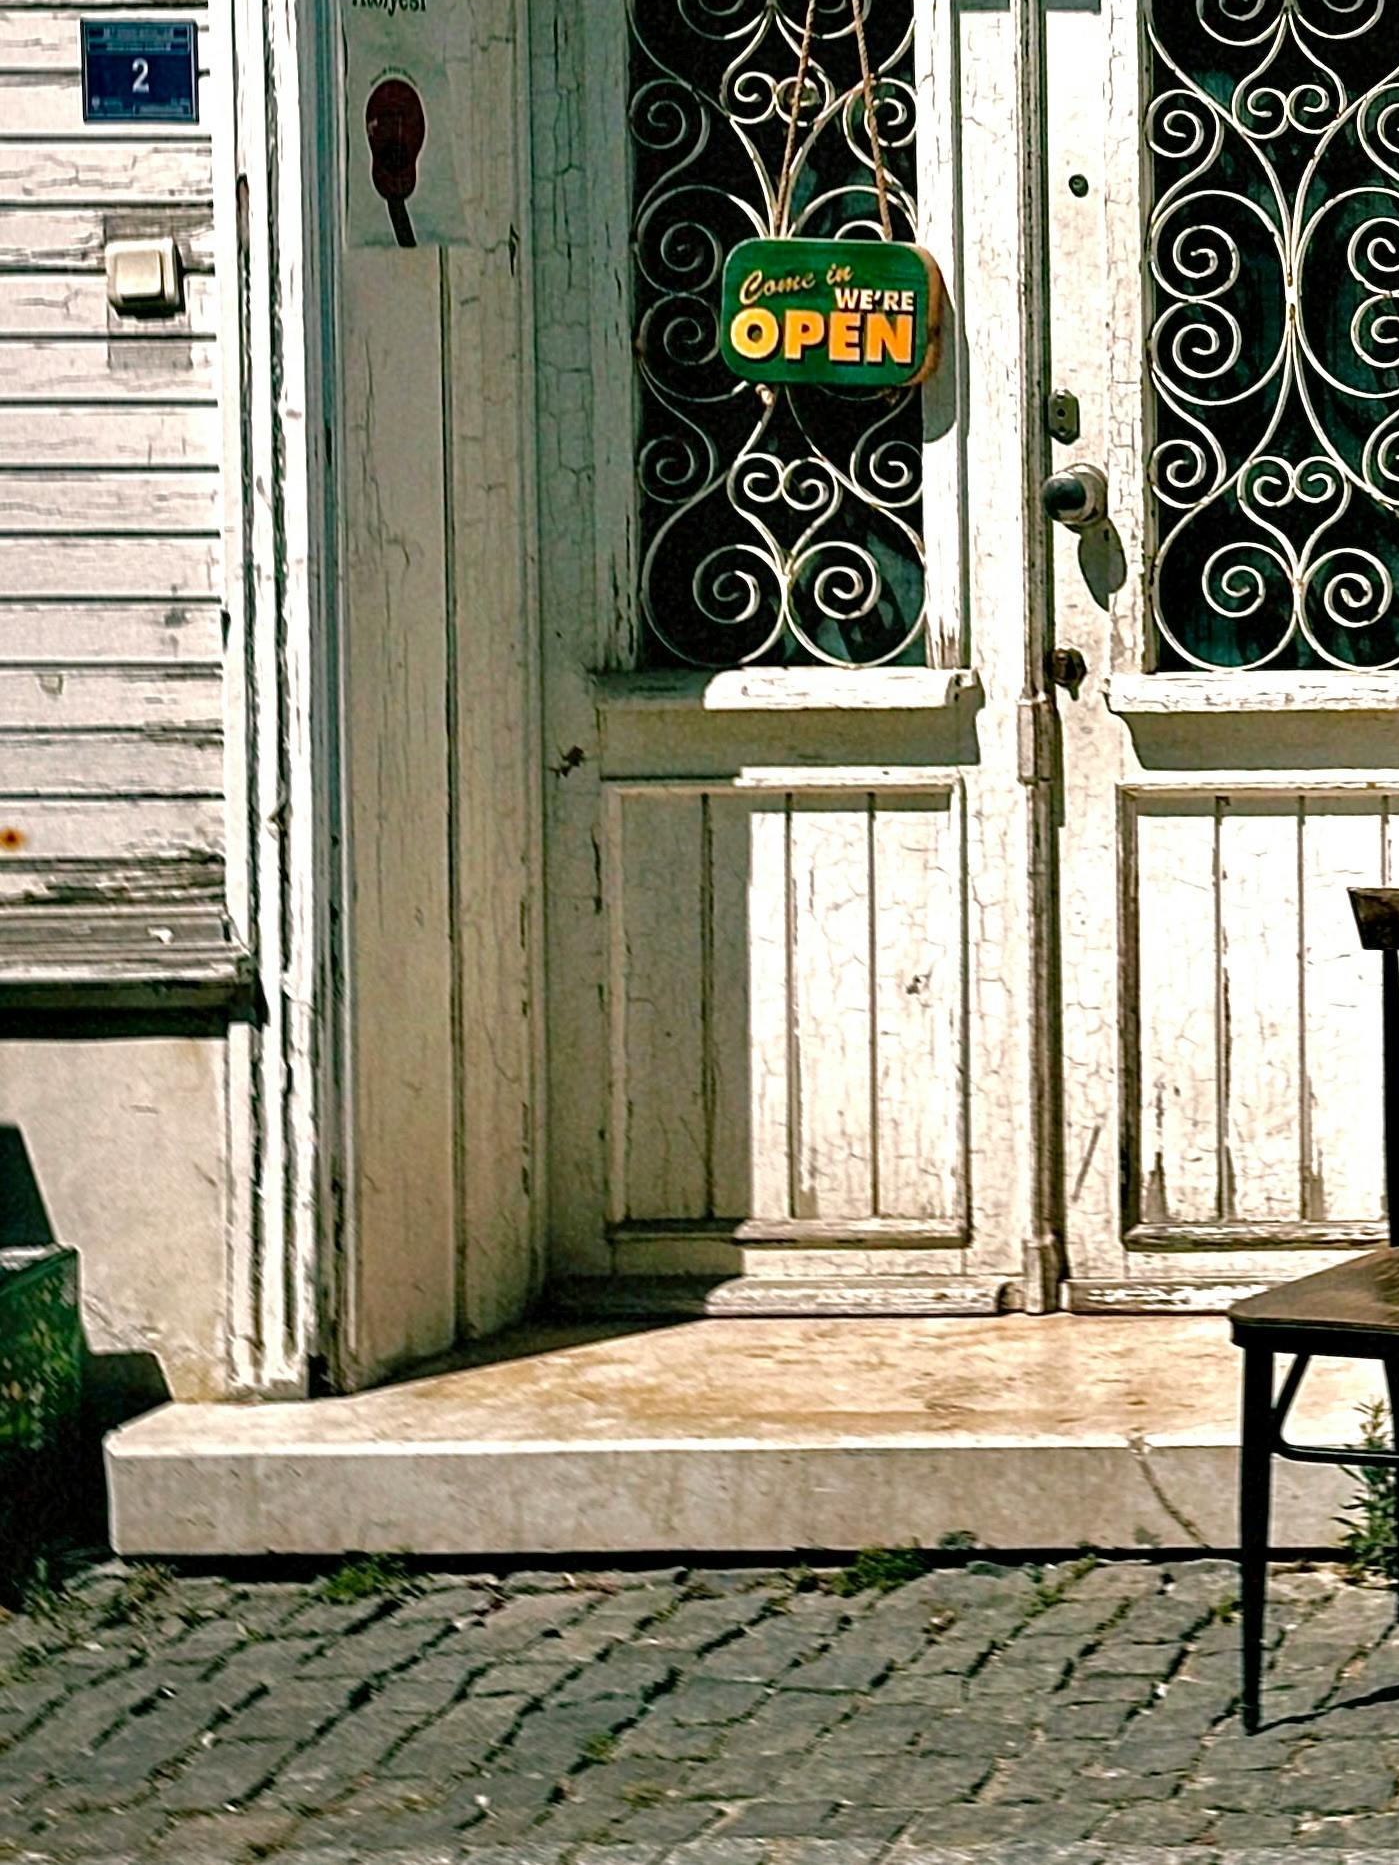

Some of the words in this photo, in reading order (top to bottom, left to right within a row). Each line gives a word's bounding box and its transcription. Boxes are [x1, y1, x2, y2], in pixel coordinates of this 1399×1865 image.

[131, 57, 150, 93] 2
[739, 269, 816, 305] Come
[826, 263, 854, 285] in
[834, 288, 915, 312] WE'RE
[730, 308, 914, 364] OPEN
